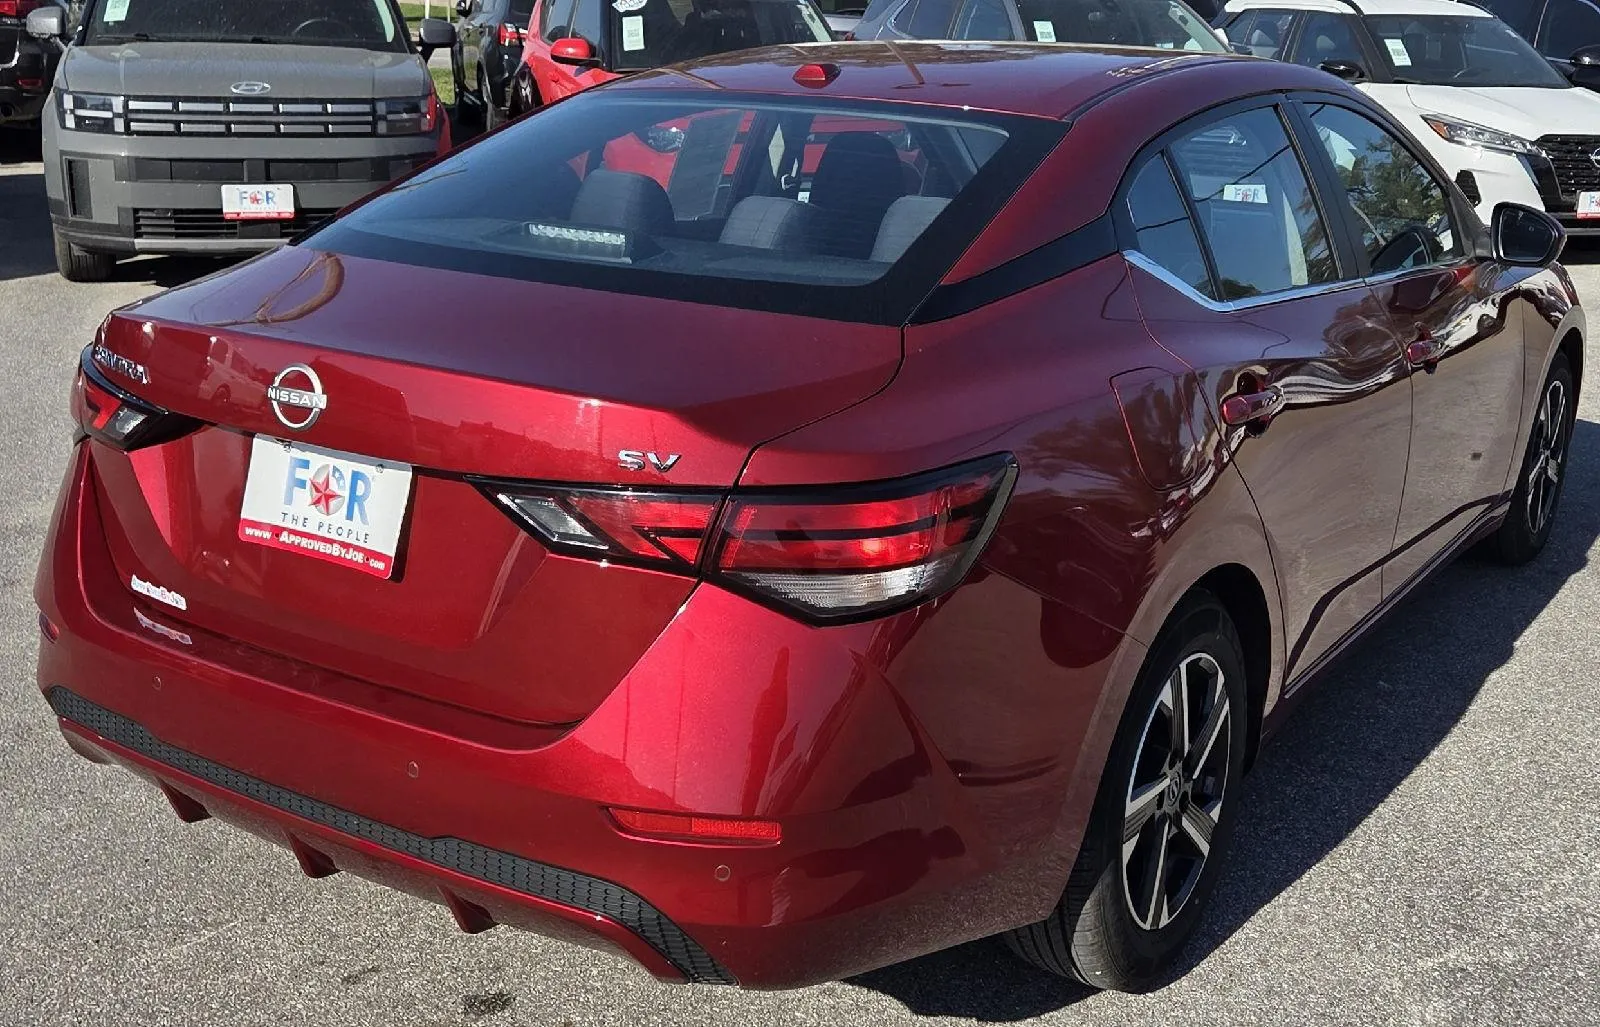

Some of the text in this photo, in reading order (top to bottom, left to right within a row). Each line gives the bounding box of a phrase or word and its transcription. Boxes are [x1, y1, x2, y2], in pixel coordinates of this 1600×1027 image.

[267, 387, 327, 408] NISSAN
[618, 449, 681, 472] SV
[283, 456, 372, 526] FOR
[281, 512, 370, 544] THE PEOPLE
